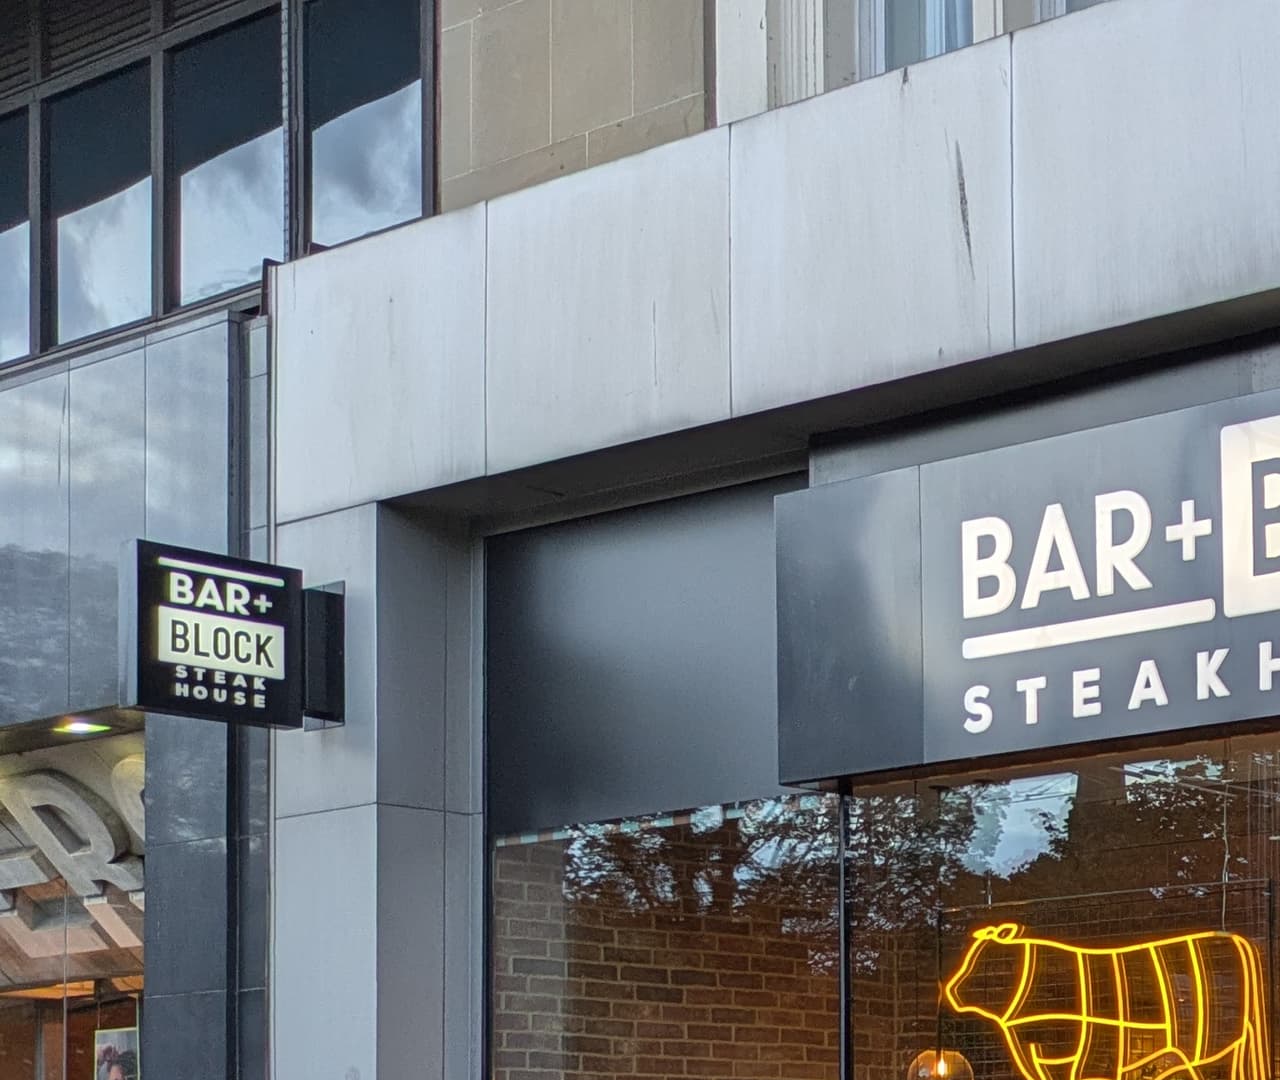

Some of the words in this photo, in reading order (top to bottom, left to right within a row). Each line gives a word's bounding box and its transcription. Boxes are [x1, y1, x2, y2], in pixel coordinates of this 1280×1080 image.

[171, 619, 274, 668] BLOCK
[175, 665, 266, 690] STEAK
[175, 683, 266, 708] HOUSE
